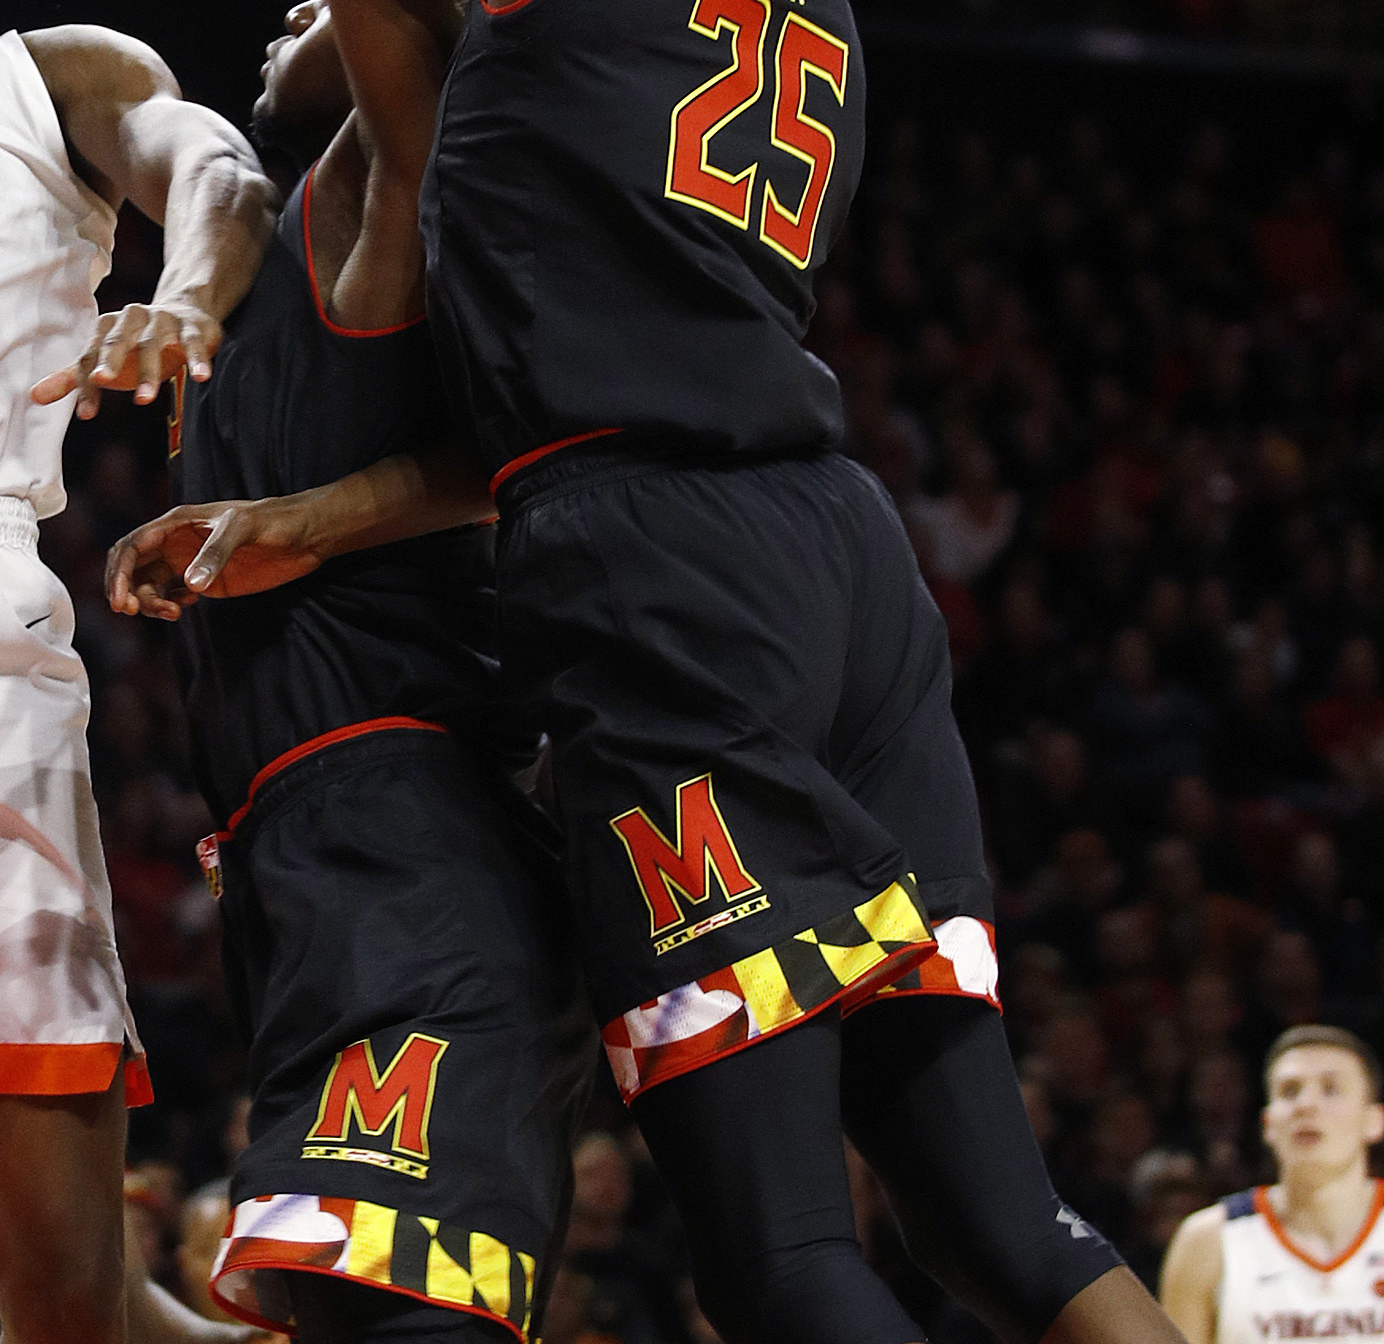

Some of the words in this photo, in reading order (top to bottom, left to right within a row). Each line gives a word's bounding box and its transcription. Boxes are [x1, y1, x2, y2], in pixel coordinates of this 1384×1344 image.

[609, 771, 763, 939] M
[304, 1032, 450, 1161] M
[1251, 1308, 1384, 1340] VIRGINI
